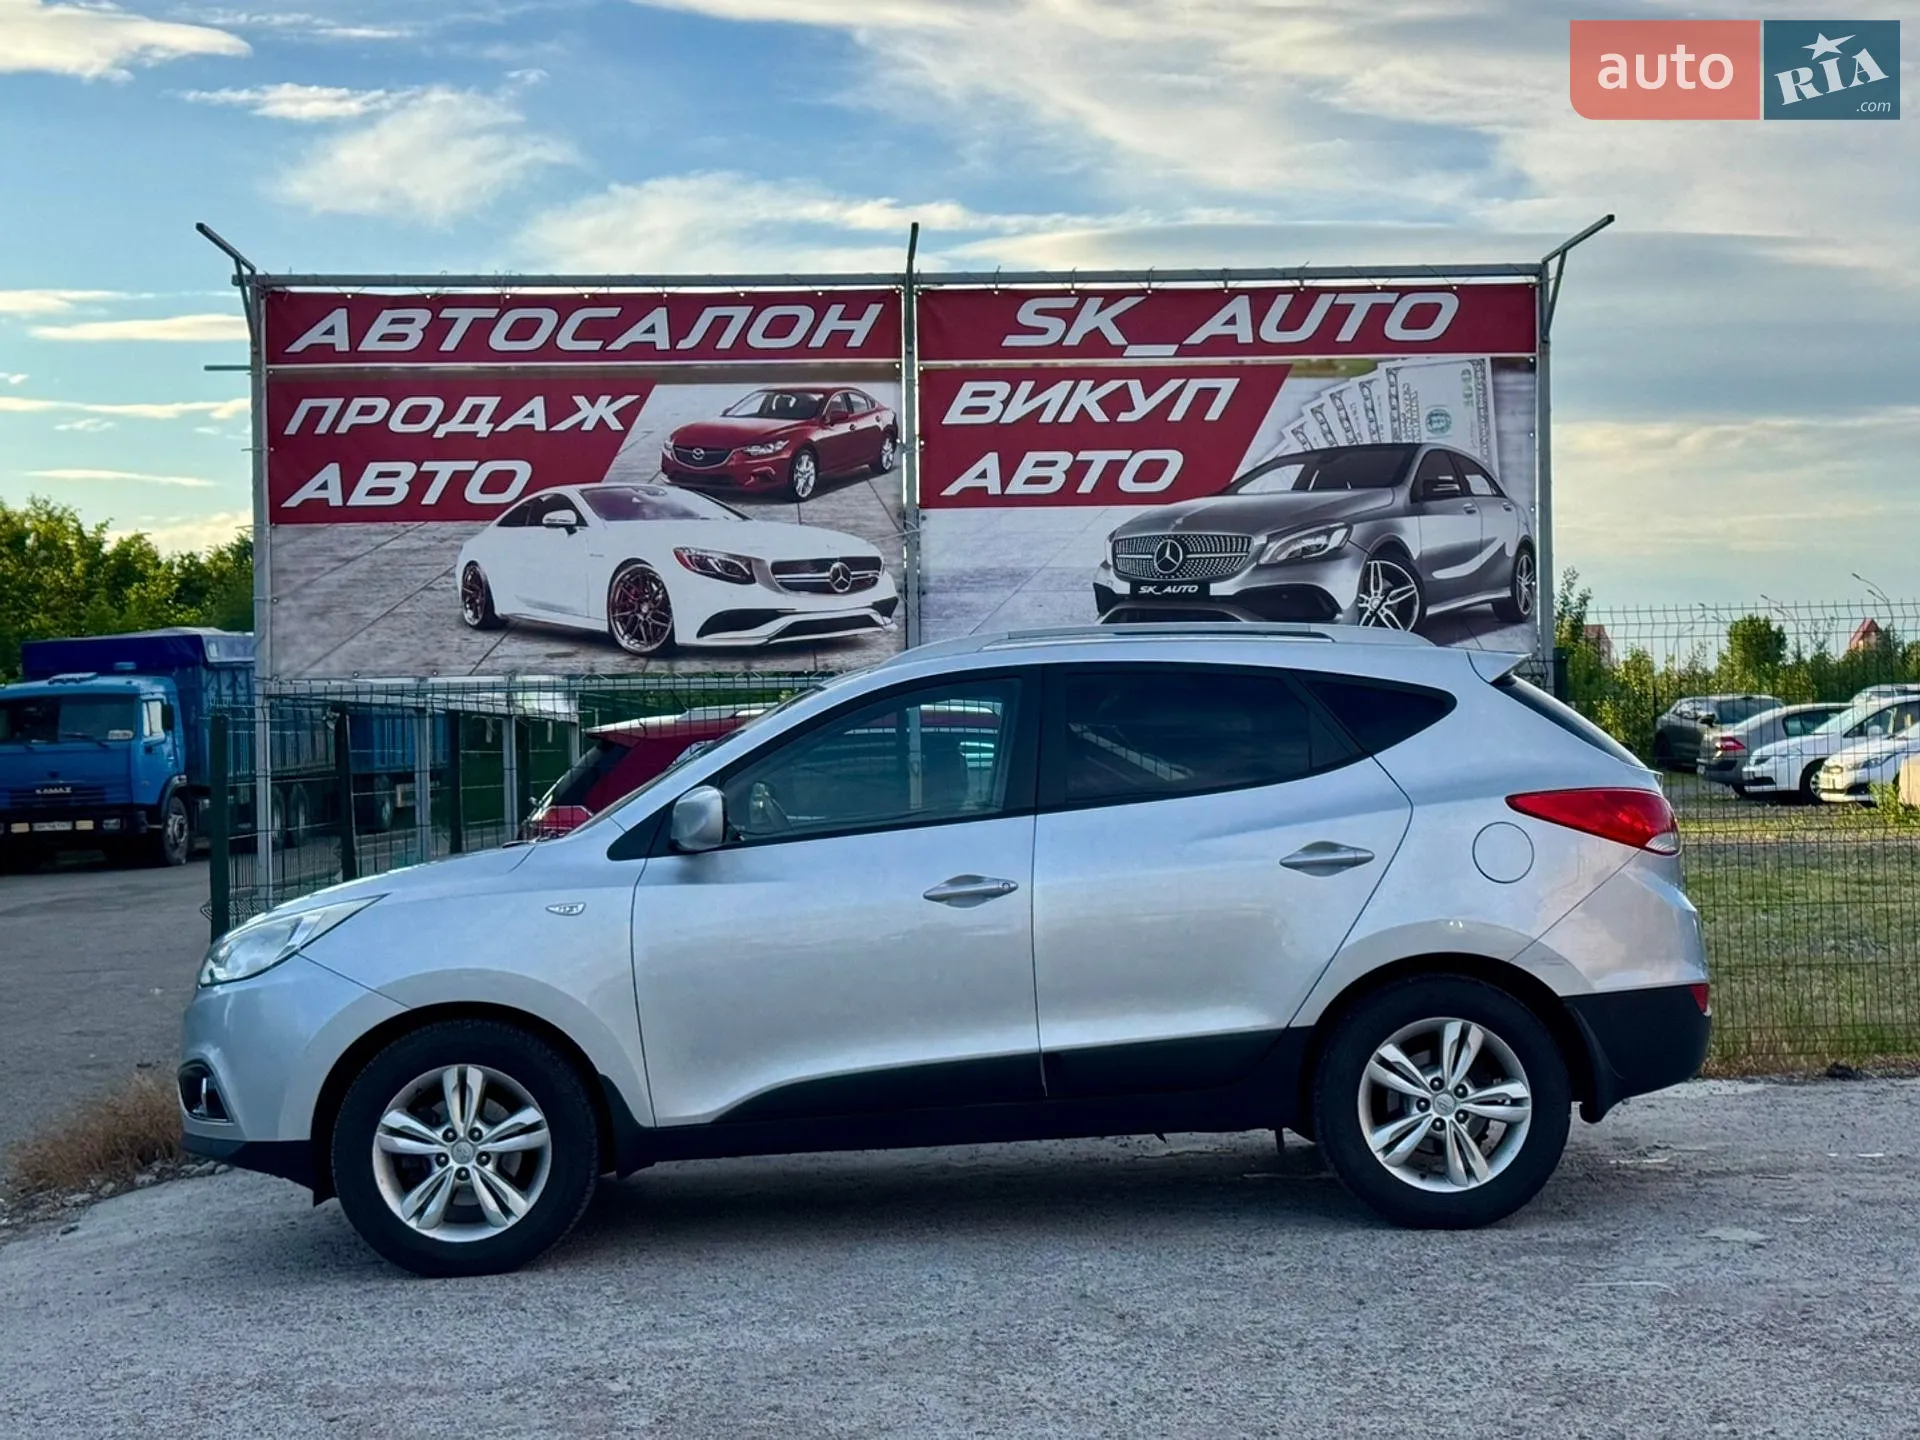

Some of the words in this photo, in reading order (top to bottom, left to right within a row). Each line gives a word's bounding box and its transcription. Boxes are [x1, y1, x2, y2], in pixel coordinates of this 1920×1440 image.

[285, 303, 884, 352] АВТОСАЛОН
[1001, 291, 1460, 357] SK_AUTO
[283, 394, 641, 439] ПРОДАЖ
[941, 377, 1240, 425] ВИКУП
[281, 460, 532, 508] АВТО
[940, 449, 1184, 497] АВТО
[1138, 584, 1199, 595] SK_AUTO
